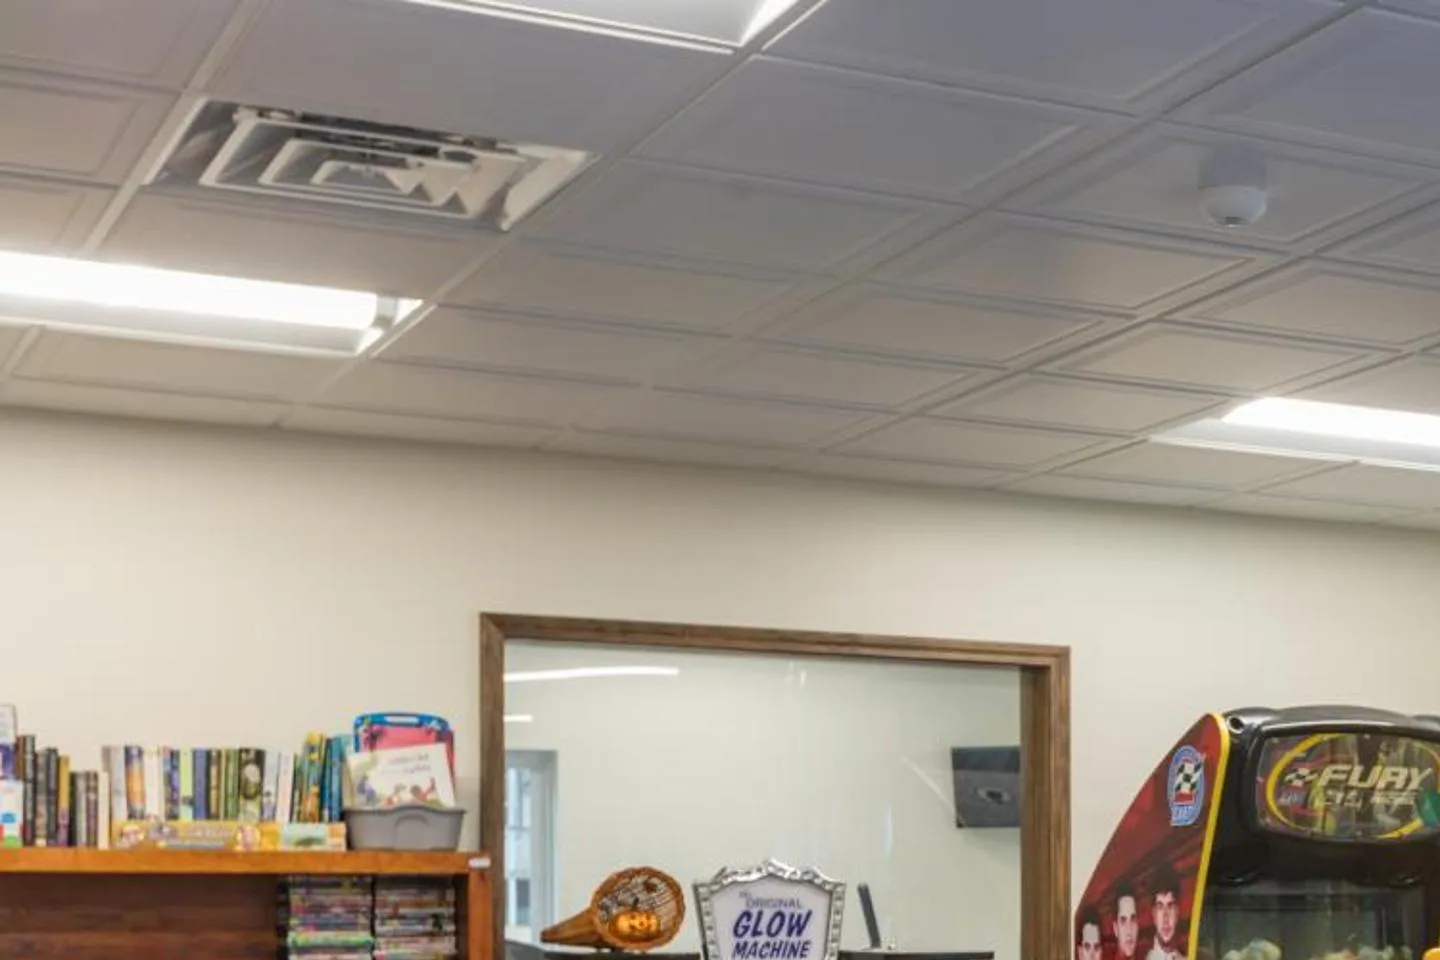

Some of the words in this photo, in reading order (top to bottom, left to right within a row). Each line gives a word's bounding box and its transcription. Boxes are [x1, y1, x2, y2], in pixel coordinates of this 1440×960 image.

[1319, 763, 1434, 790] FURY
[746, 898, 804, 910] ORIGINAL
[732, 909, 813, 939] GLOW
[731, 939, 812, 960] MACHINE
